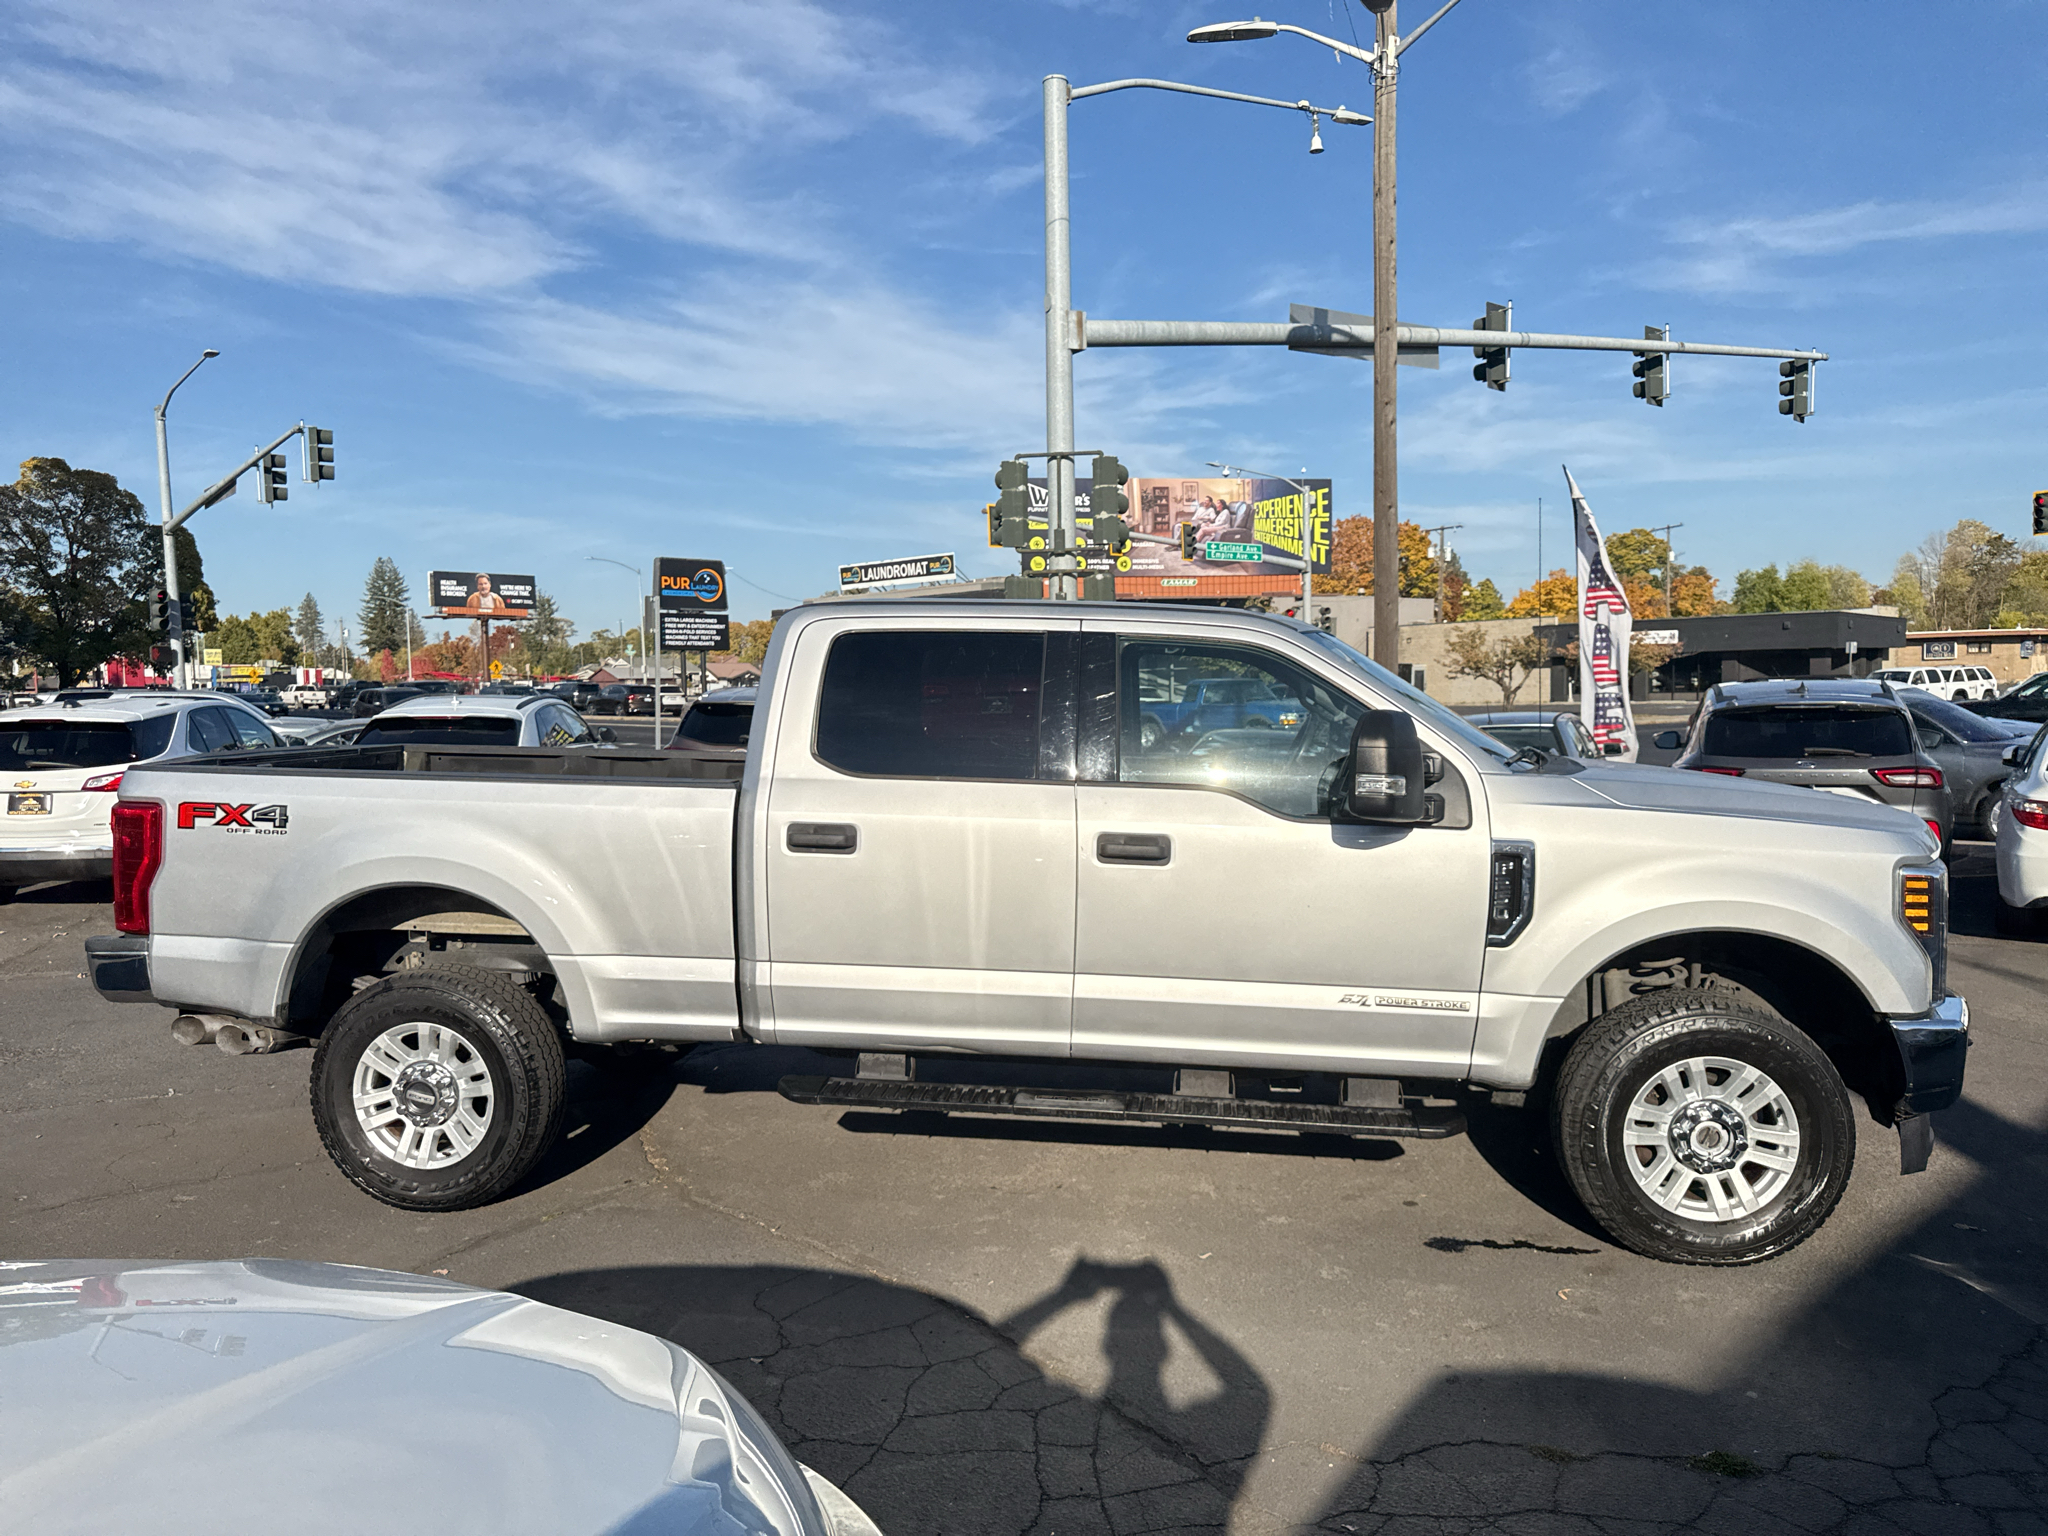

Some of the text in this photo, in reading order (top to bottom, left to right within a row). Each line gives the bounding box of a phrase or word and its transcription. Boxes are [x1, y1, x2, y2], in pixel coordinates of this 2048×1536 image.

[1218, 543, 1243, 552] Garland
[1211, 550, 1249, 560] Empire Ave.
[861, 561, 928, 582] LAUNDROMAT
[661, 575, 691, 590] PUR
[177, 801, 289, 830] FX4
[255, 828, 287, 836] ROAD
[1378, 997, 1418, 1006] POWER
[1420, 999, 1468, 1010] STROKE
